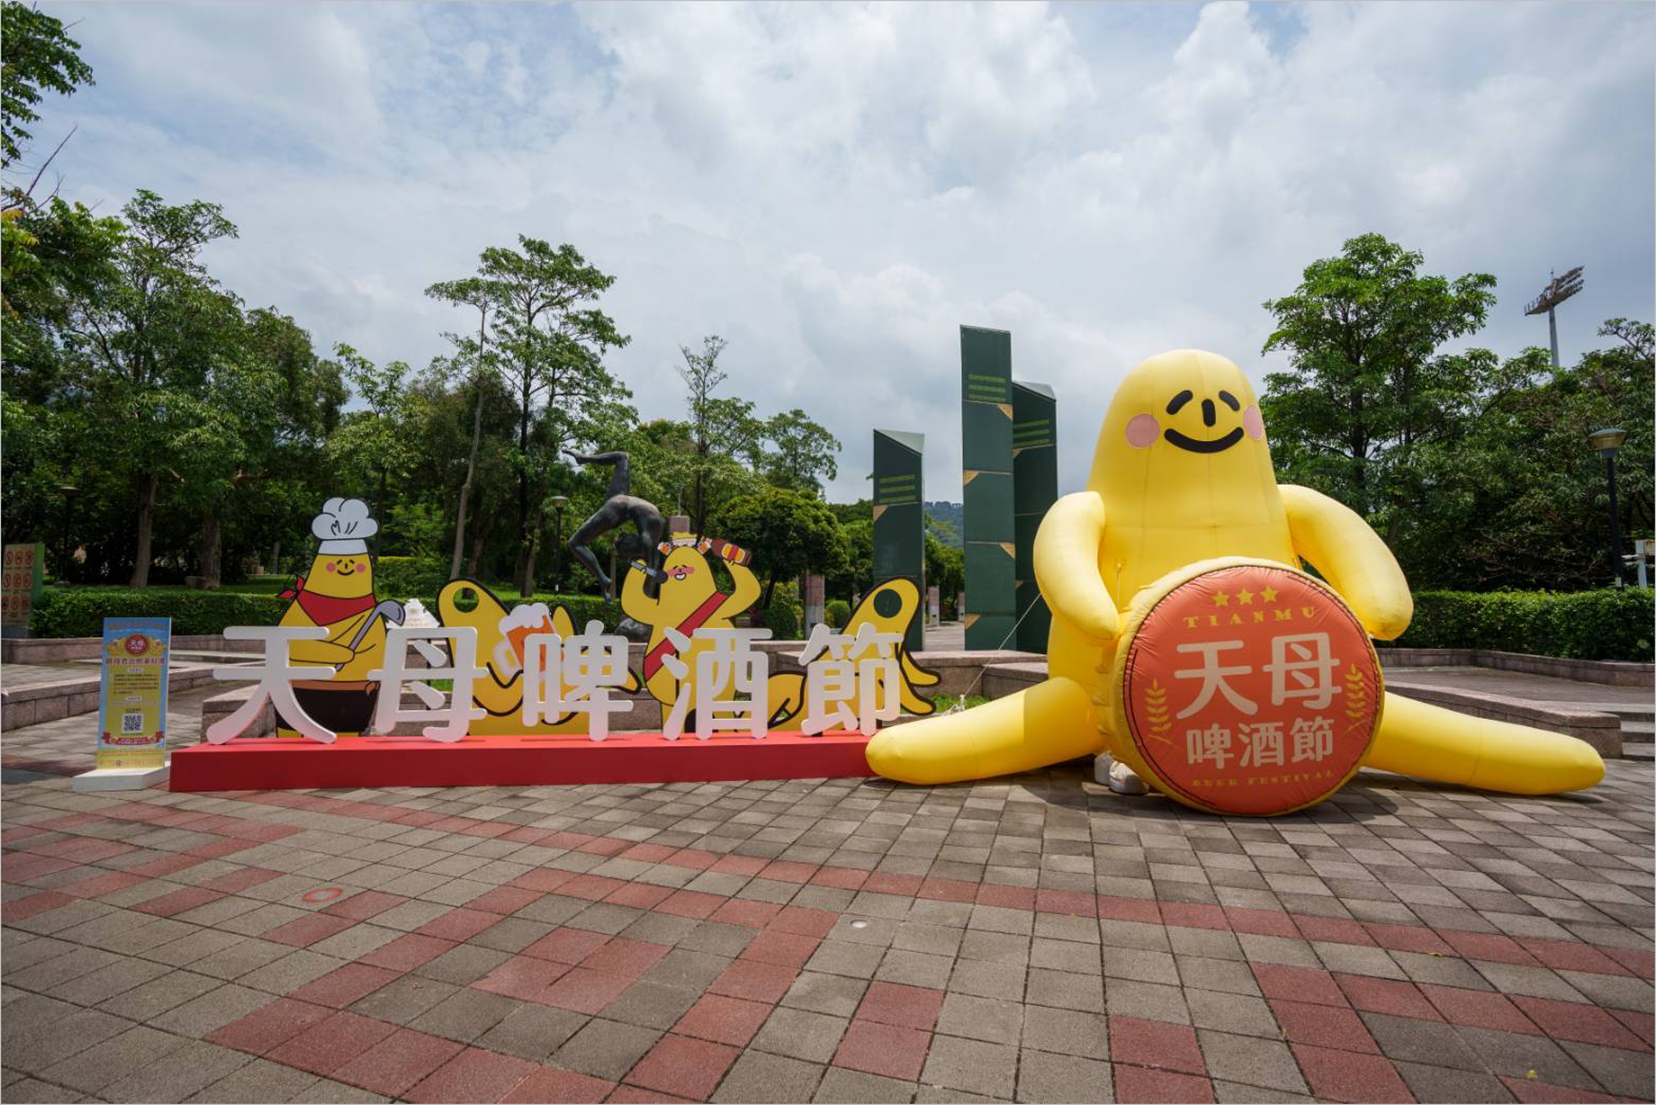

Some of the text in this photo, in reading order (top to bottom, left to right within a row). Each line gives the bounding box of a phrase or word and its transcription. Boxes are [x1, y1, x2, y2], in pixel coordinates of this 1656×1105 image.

[1183, 606, 1316, 629] TIANMU
[206, 619, 904, 746] 天母啤酒節
[1174, 632, 1343, 719] 天母
[1186, 716, 1335, 770] 啤酒節
[1192, 769, 1334, 787] BEER FESTIVAL
